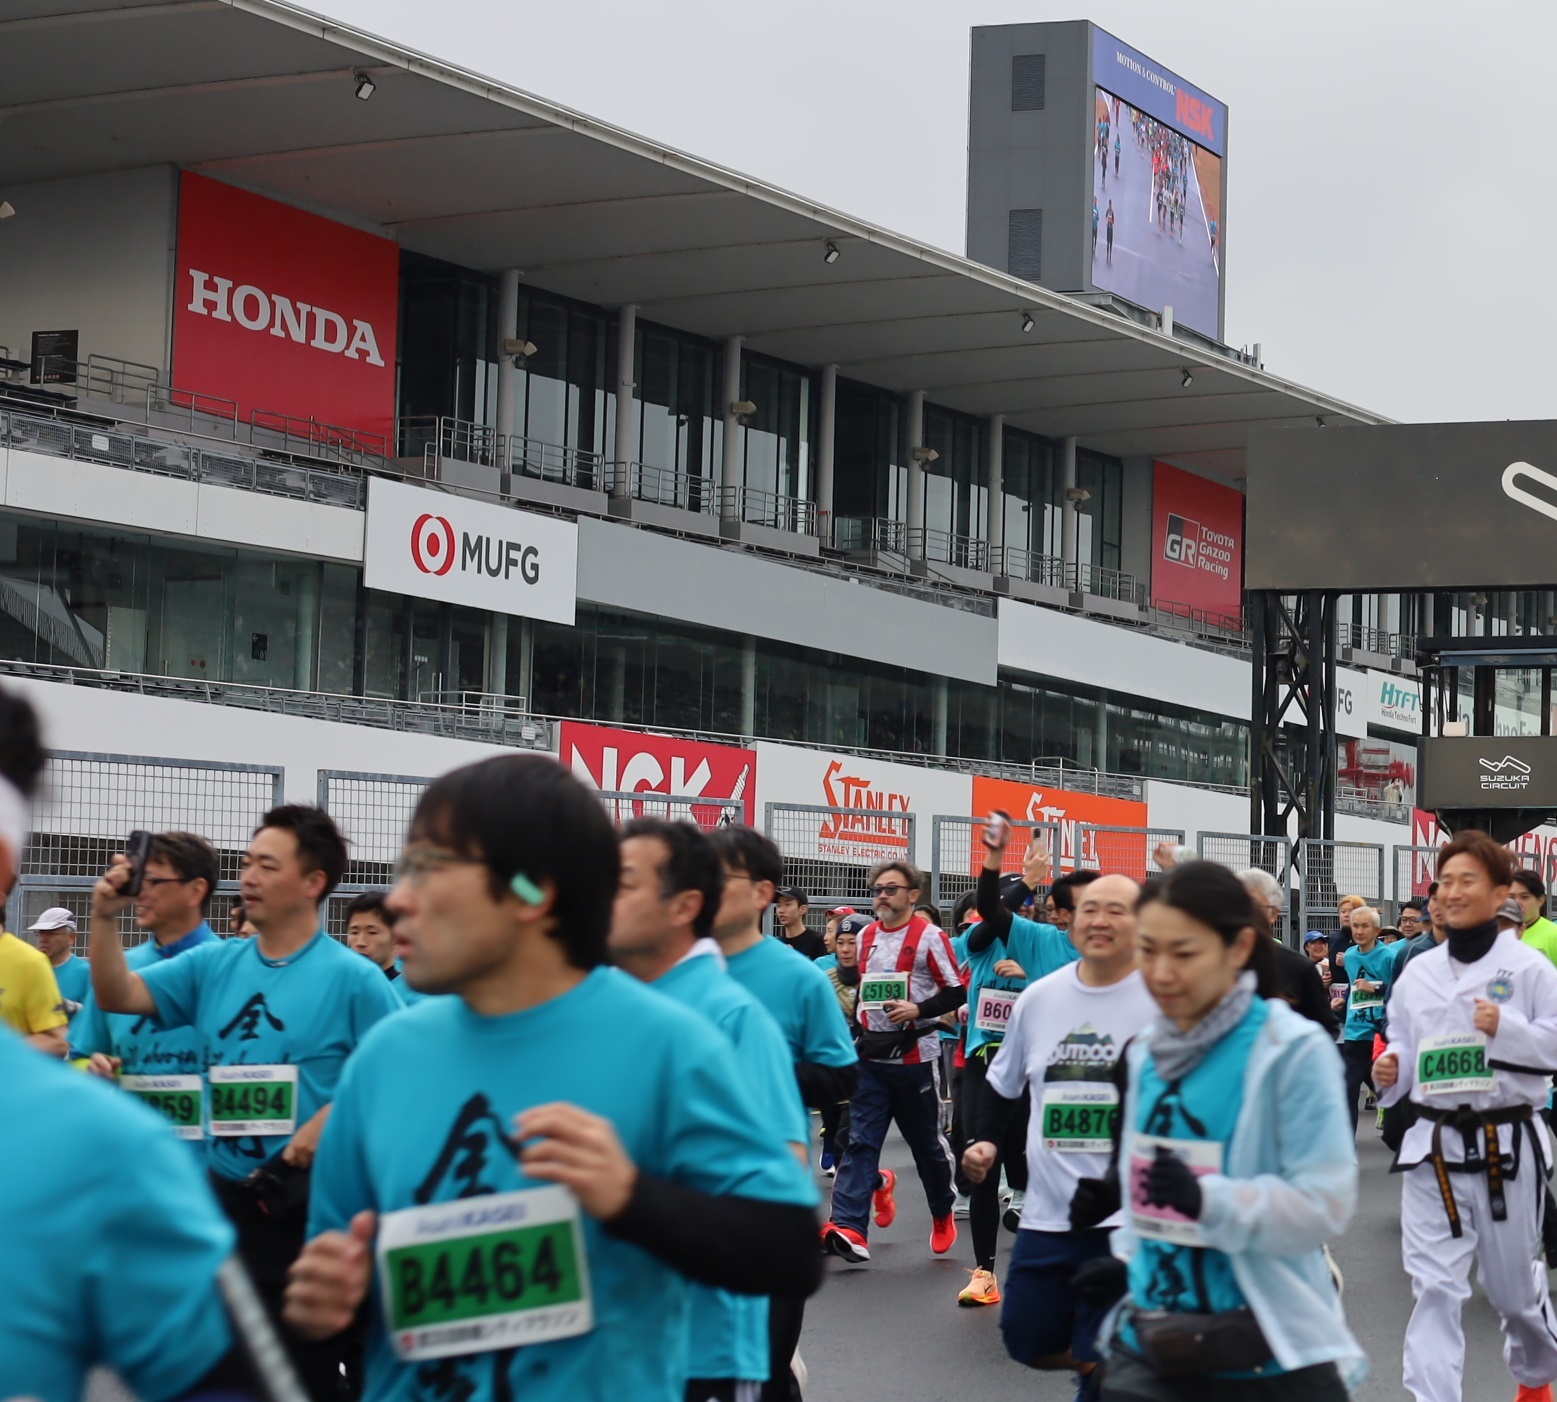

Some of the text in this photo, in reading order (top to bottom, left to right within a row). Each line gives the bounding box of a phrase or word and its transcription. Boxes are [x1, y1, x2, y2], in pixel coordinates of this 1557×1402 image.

[1116, 51, 1141, 75] MOTION
[1146, 70, 1175, 96] CONTROL
[1176, 89, 1215, 141] NSK
[187, 268, 385, 367] HONDA
[1166, 533, 1195, 565] GR
[1200, 541, 1231, 562] GAZOO
[1201, 526, 1234, 549] TOYOTA
[461, 531, 540, 586] MUFG
[1198, 556, 1229, 580] Racing
[1380, 681, 1419, 711] HTFT
[1479, 774, 1530, 782] SUZUKA
[1480, 782, 1529, 790] CIRCUIT
[819, 760, 911, 838] STANLEY
[1424, 1050, 1486, 1078] C4668
[212, 1086, 286, 1116] B4494
[400, 1232, 563, 1318] B4464
